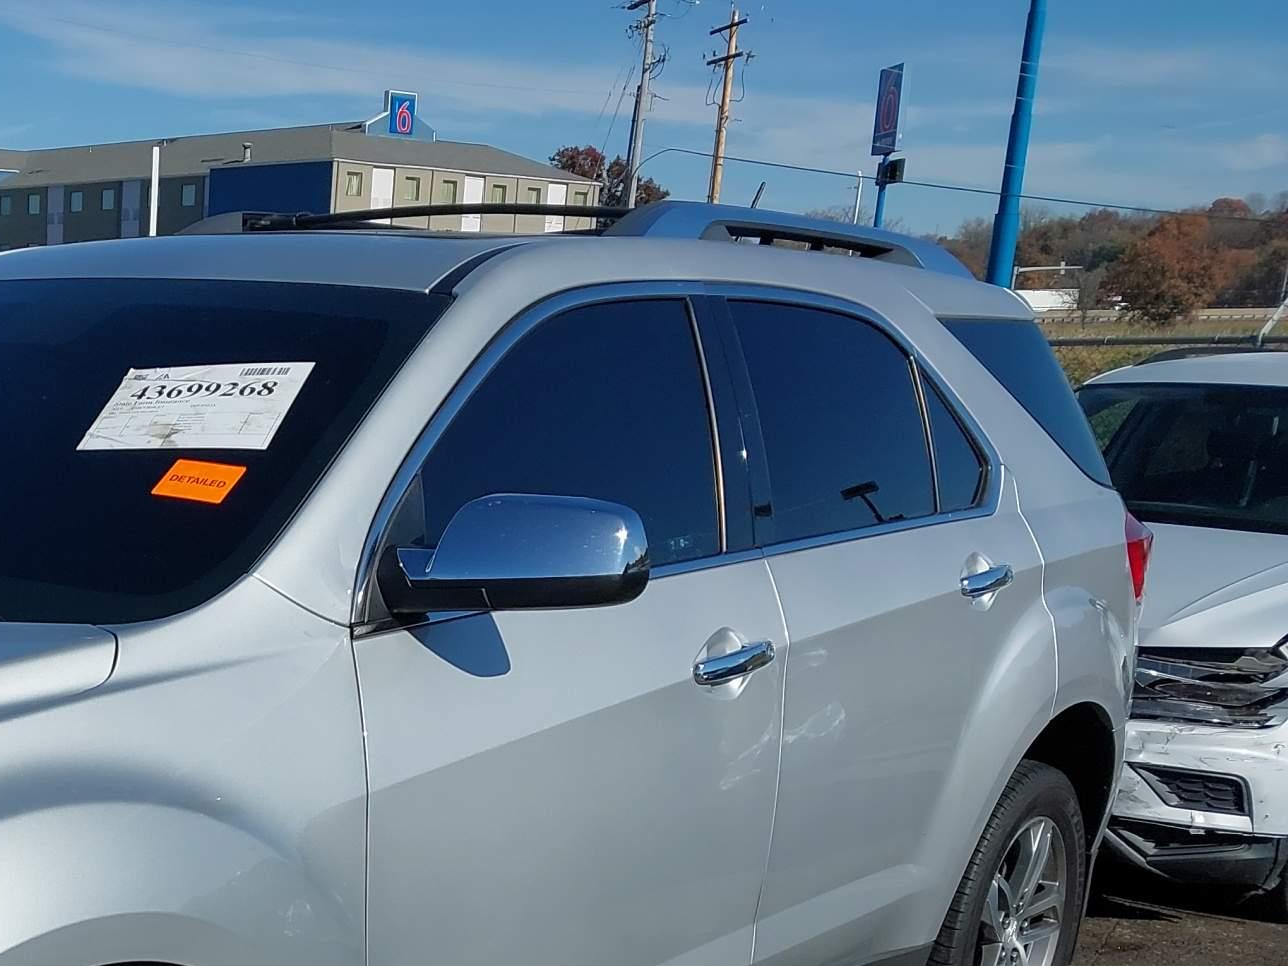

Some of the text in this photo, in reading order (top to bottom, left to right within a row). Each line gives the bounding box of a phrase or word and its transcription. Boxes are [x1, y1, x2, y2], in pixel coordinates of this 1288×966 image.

[396, 100, 412, 134] 6
[130, 380, 279, 400] 43699268
[169, 473, 227, 489] DETAILED
